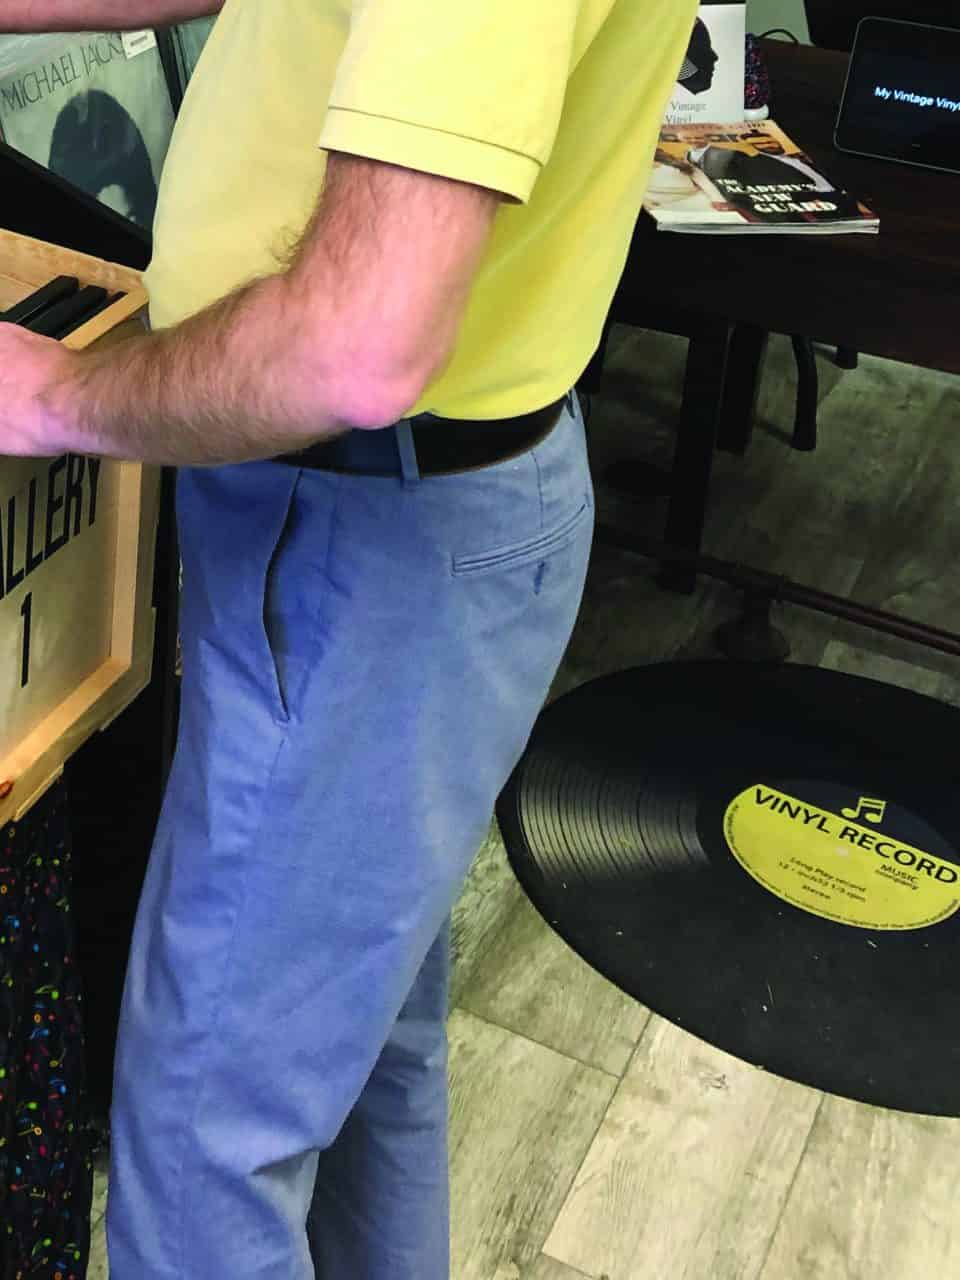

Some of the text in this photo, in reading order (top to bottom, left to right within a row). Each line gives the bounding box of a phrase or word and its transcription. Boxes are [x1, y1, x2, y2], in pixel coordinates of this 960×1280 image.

[1, 52, 80, 111] MICHAEL
[670, 99, 708, 113] Vintage
[874, 86, 892, 100] My
[894, 89, 934, 107] Vintage
[749, 194, 793, 202] NEW
[753, 201, 838, 213] GUARD
[20, 591, 33, 689] 1
[754, 788, 831, 834] VINYL
[839, 825, 958, 884] RECORD
[880, 863, 919, 884] MUSIC
